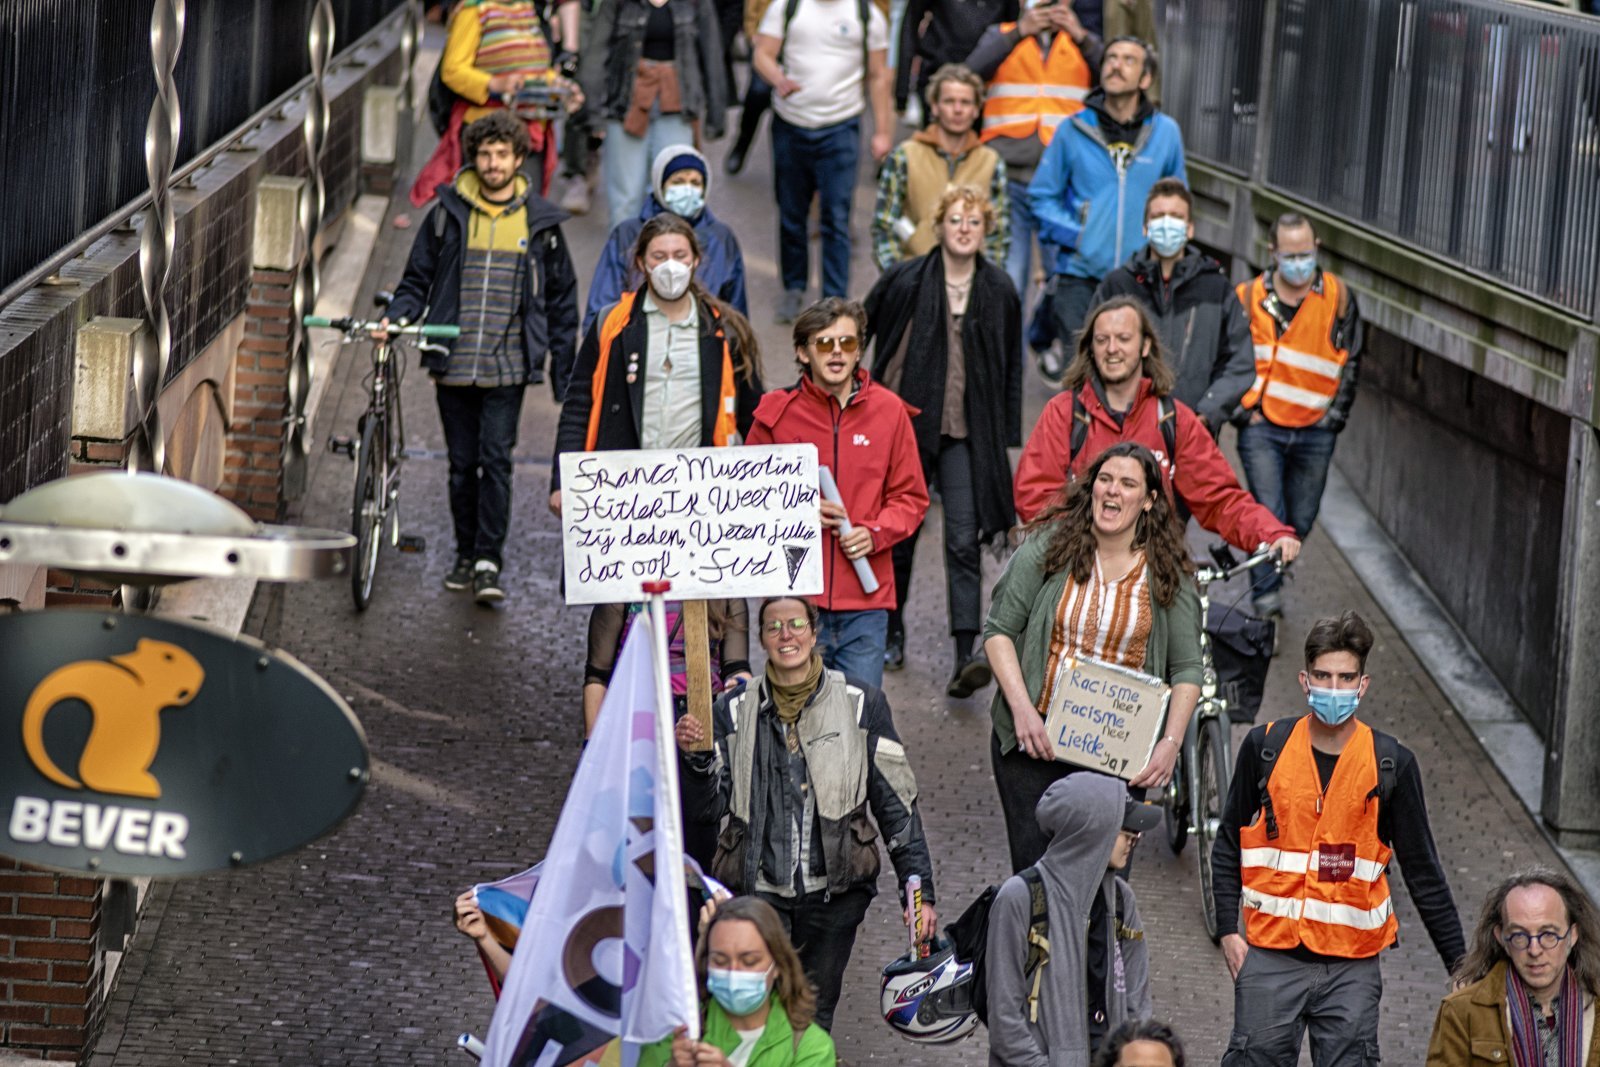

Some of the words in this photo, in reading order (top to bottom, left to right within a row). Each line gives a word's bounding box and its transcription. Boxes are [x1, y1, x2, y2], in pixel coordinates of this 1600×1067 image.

[676, 453, 804, 481] Mussolini
[620, 524, 687, 549] deden,
[579, 554, 625, 583] dat
[1069, 669, 1140, 703] Racisme
[1062, 699, 1125, 729] Facisme
[1112, 698, 1143, 717] nee!
[1057, 724, 1105, 758] Liefde
[1102, 724, 1131, 742] nee!
[8, 795, 190, 860] BEVER
